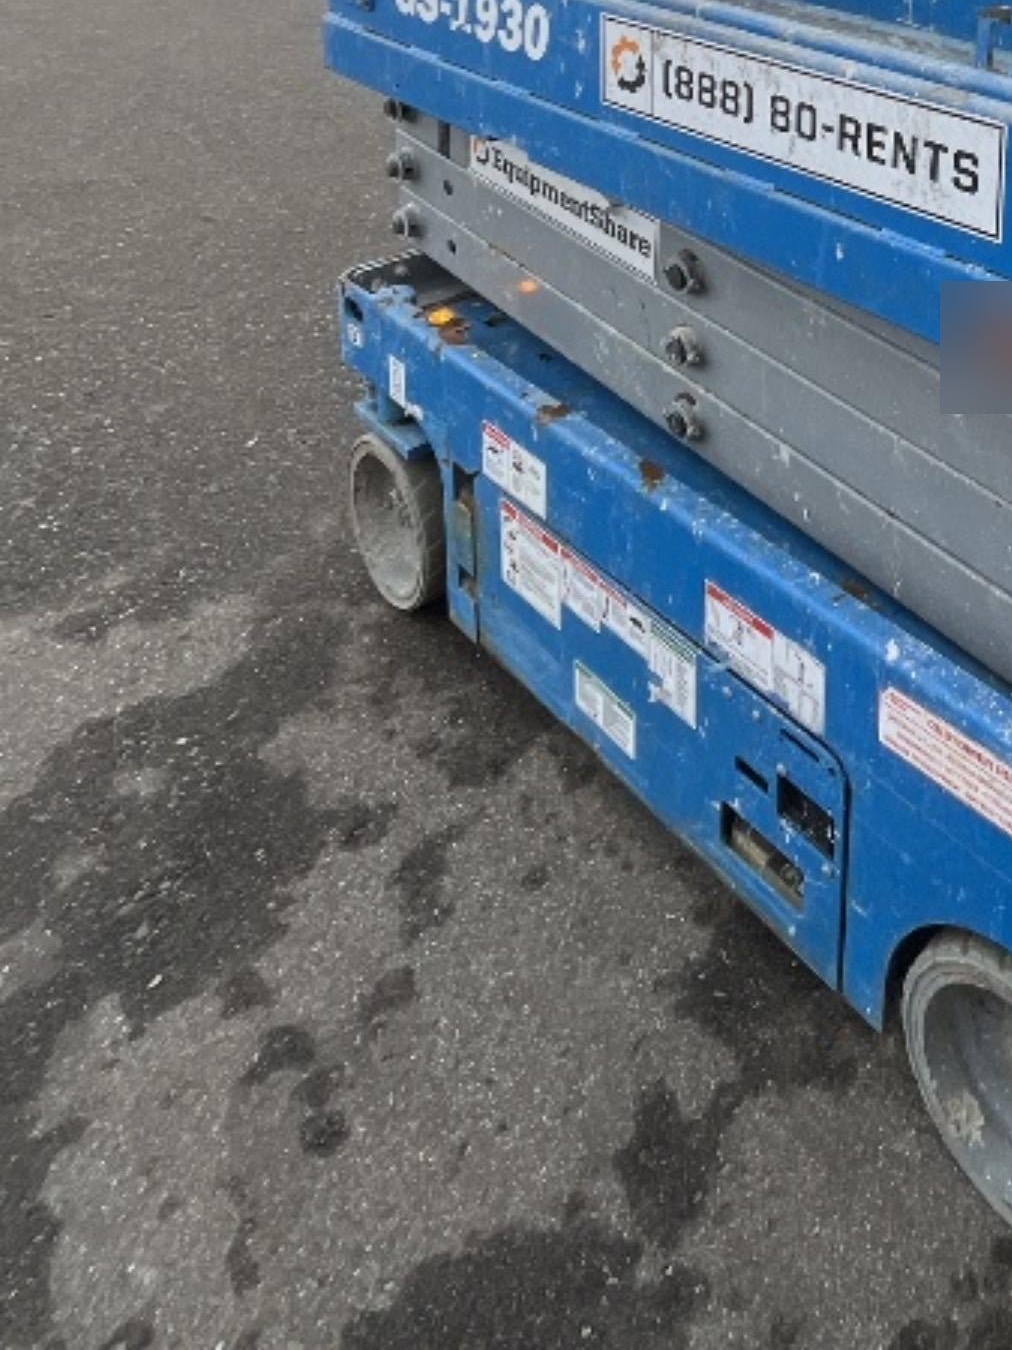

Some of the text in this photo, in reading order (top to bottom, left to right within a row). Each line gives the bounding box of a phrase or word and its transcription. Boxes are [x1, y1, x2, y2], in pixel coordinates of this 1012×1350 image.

[663, 59, 980, 195] (888) 80-RENTS
[491, 146, 651, 258] EquipmentShare
